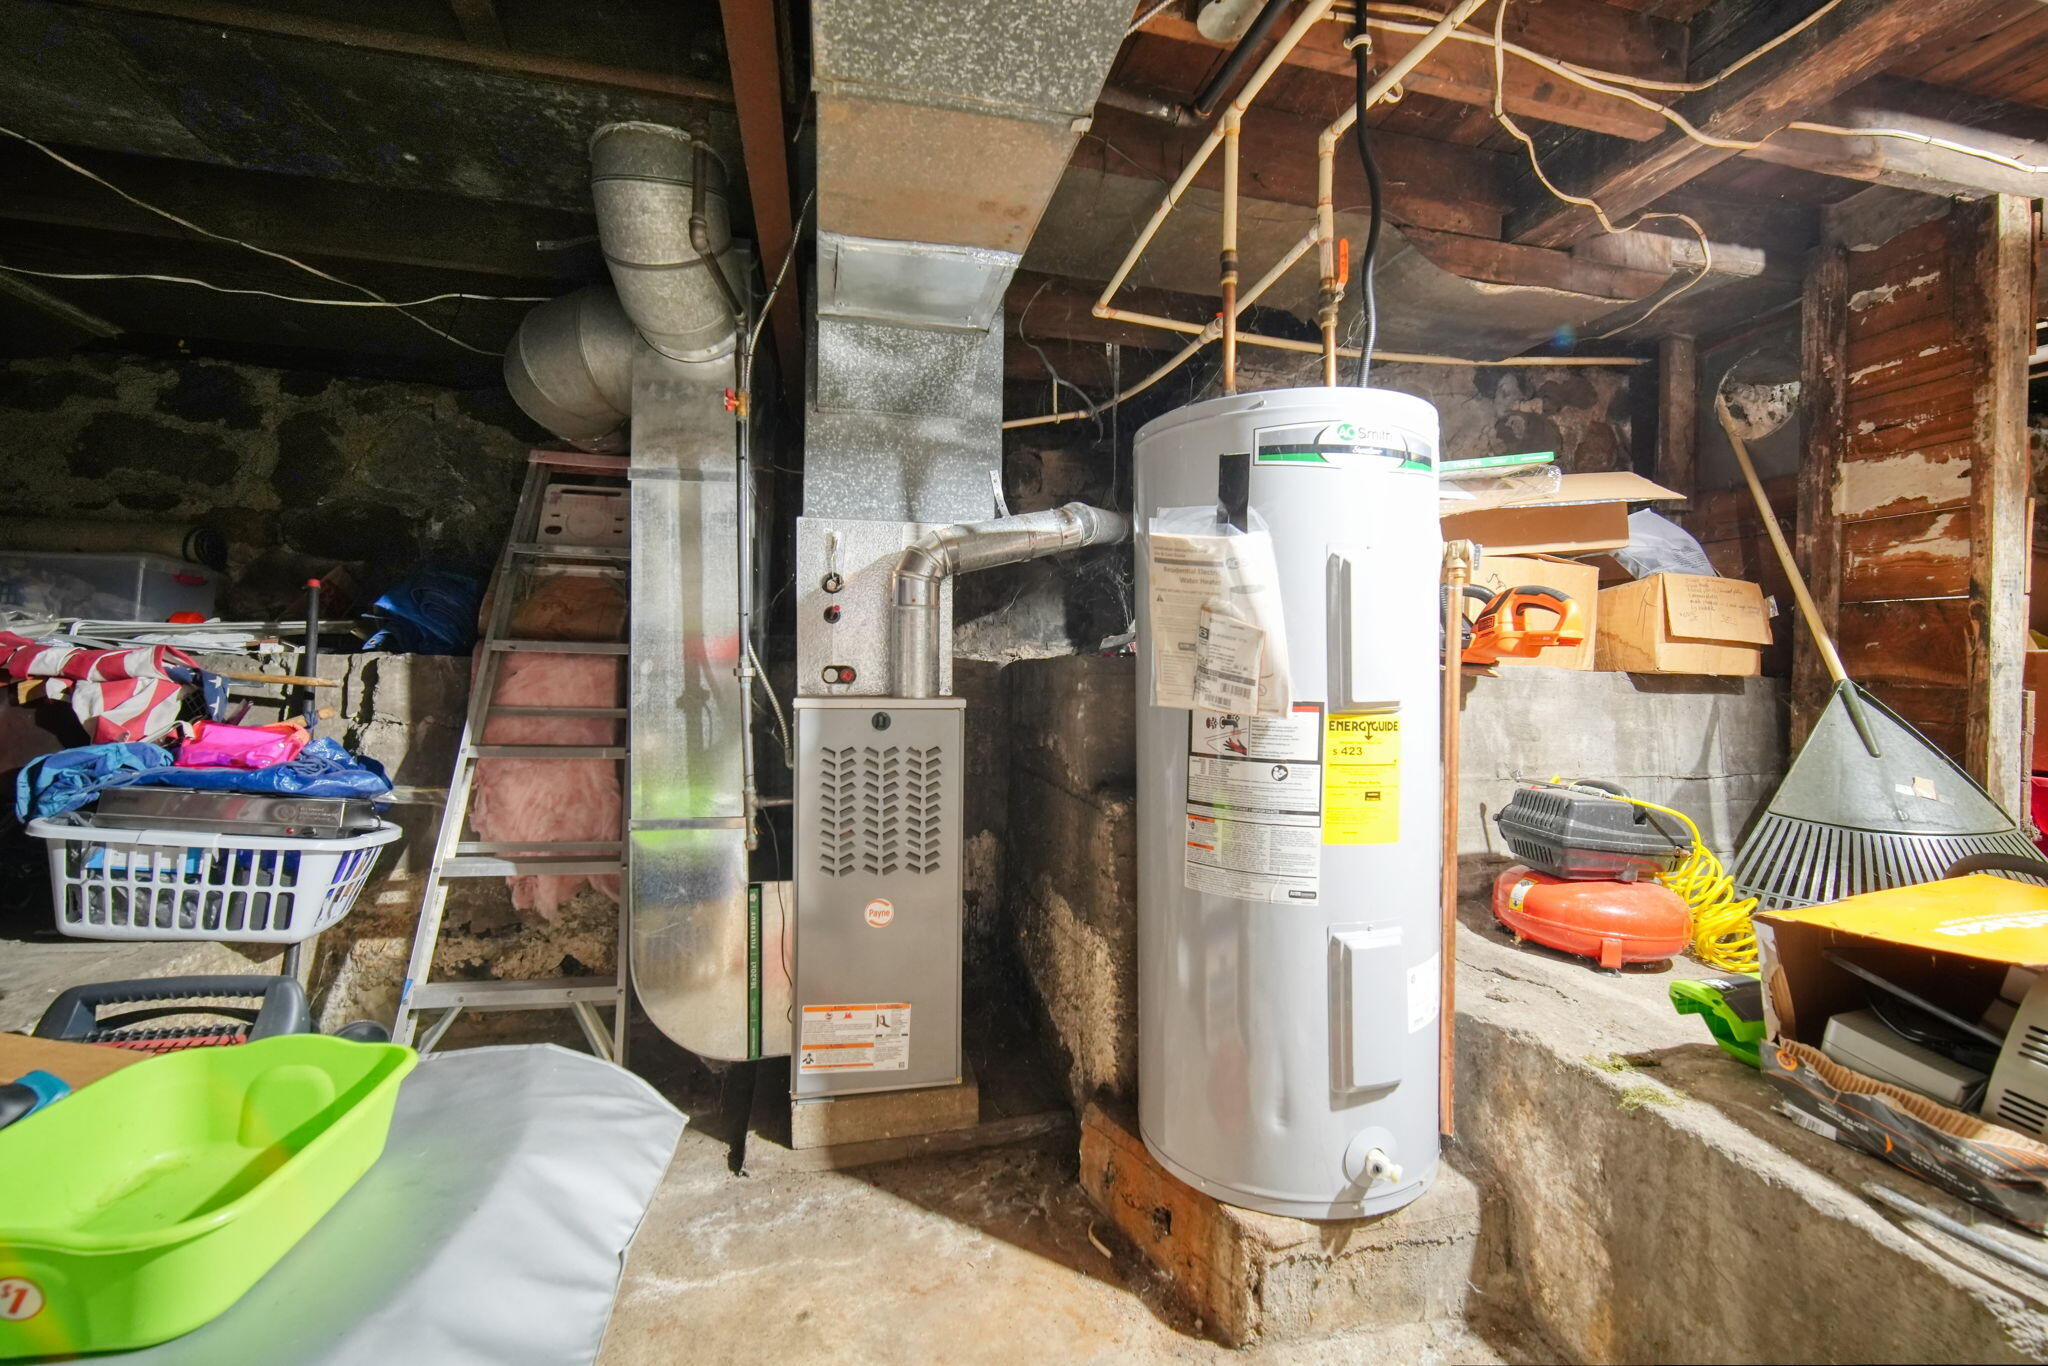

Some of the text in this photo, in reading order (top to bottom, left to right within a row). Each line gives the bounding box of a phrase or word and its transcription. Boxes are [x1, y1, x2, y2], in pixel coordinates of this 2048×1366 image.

[1328, 720, 1399, 735] ENERGYGUIDE
[1341, 746, 1363, 756] 423
[868, 909, 891, 918] Payne
